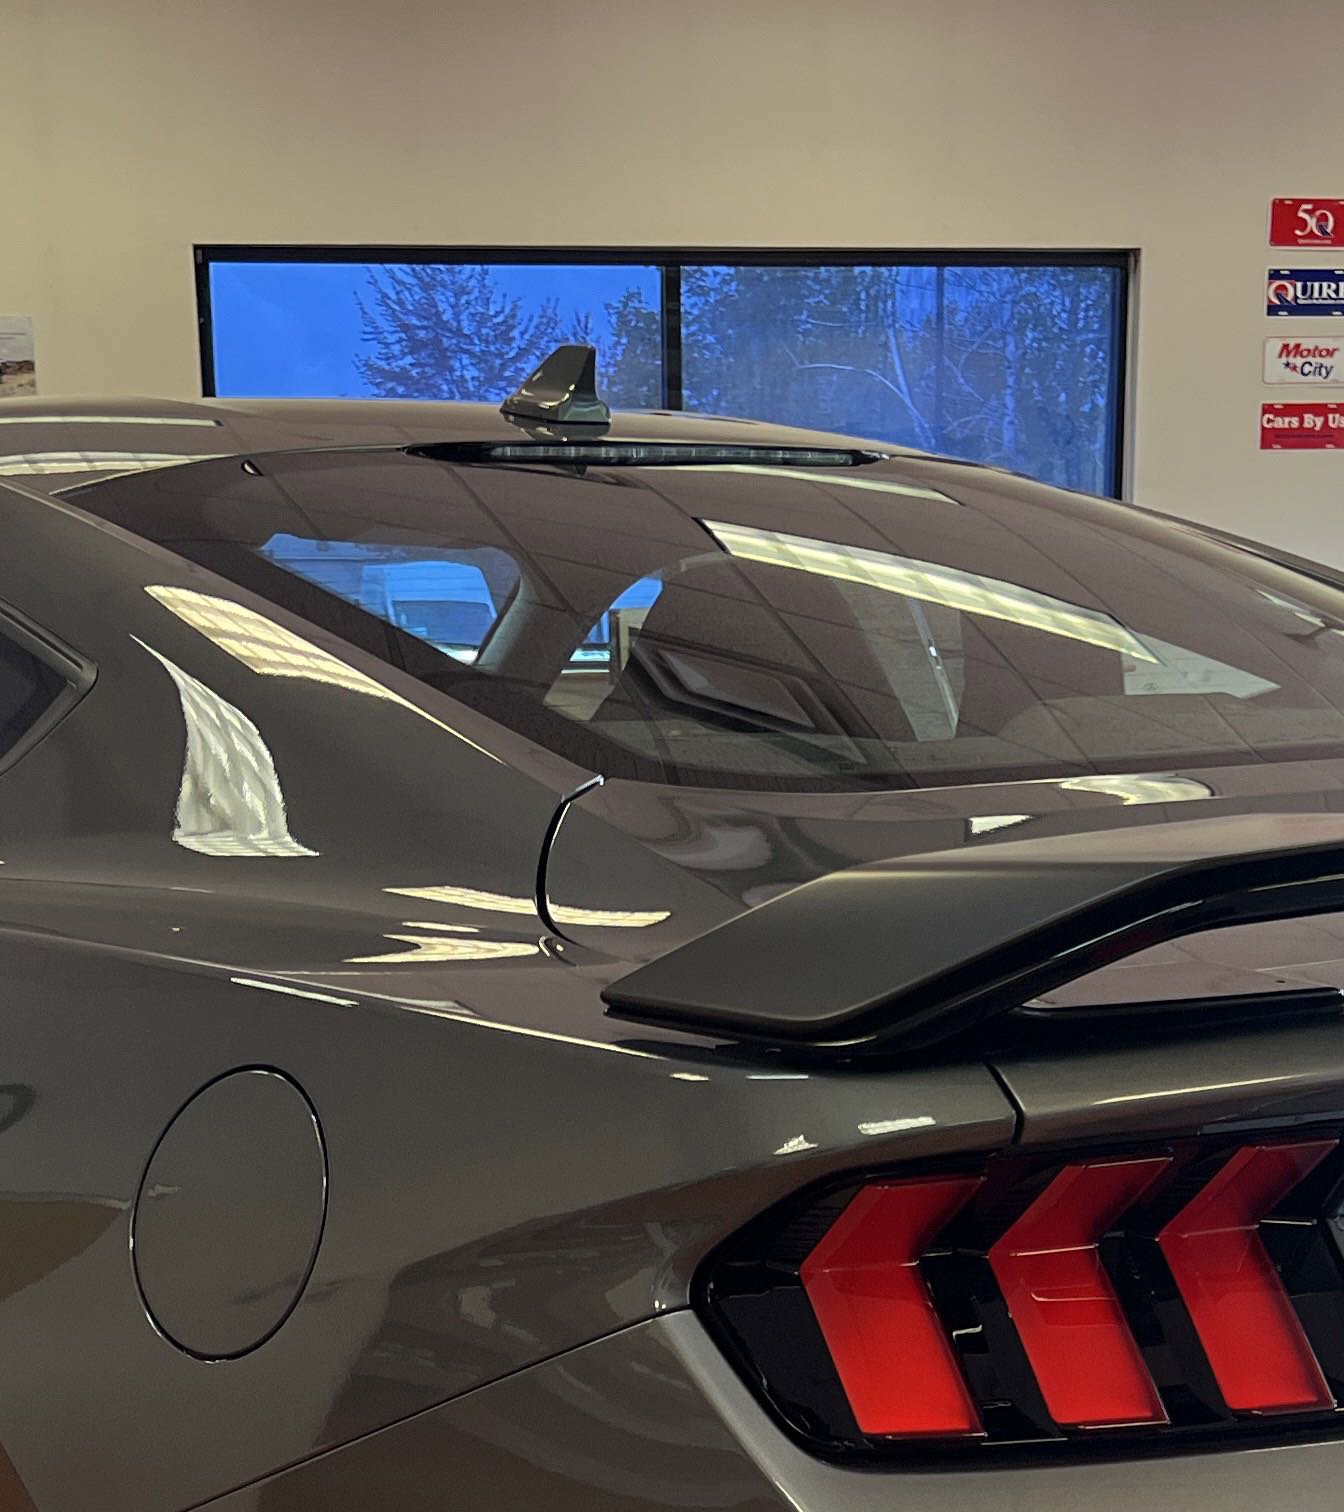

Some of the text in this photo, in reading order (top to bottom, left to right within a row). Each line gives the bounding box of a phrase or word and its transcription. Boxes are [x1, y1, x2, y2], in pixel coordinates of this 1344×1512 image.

[1278, 343, 1339, 359] Motor
[1300, 360, 1334, 379] City
[1262, 413, 1299, 429] Cars
[1303, 413, 1324, 431] By
